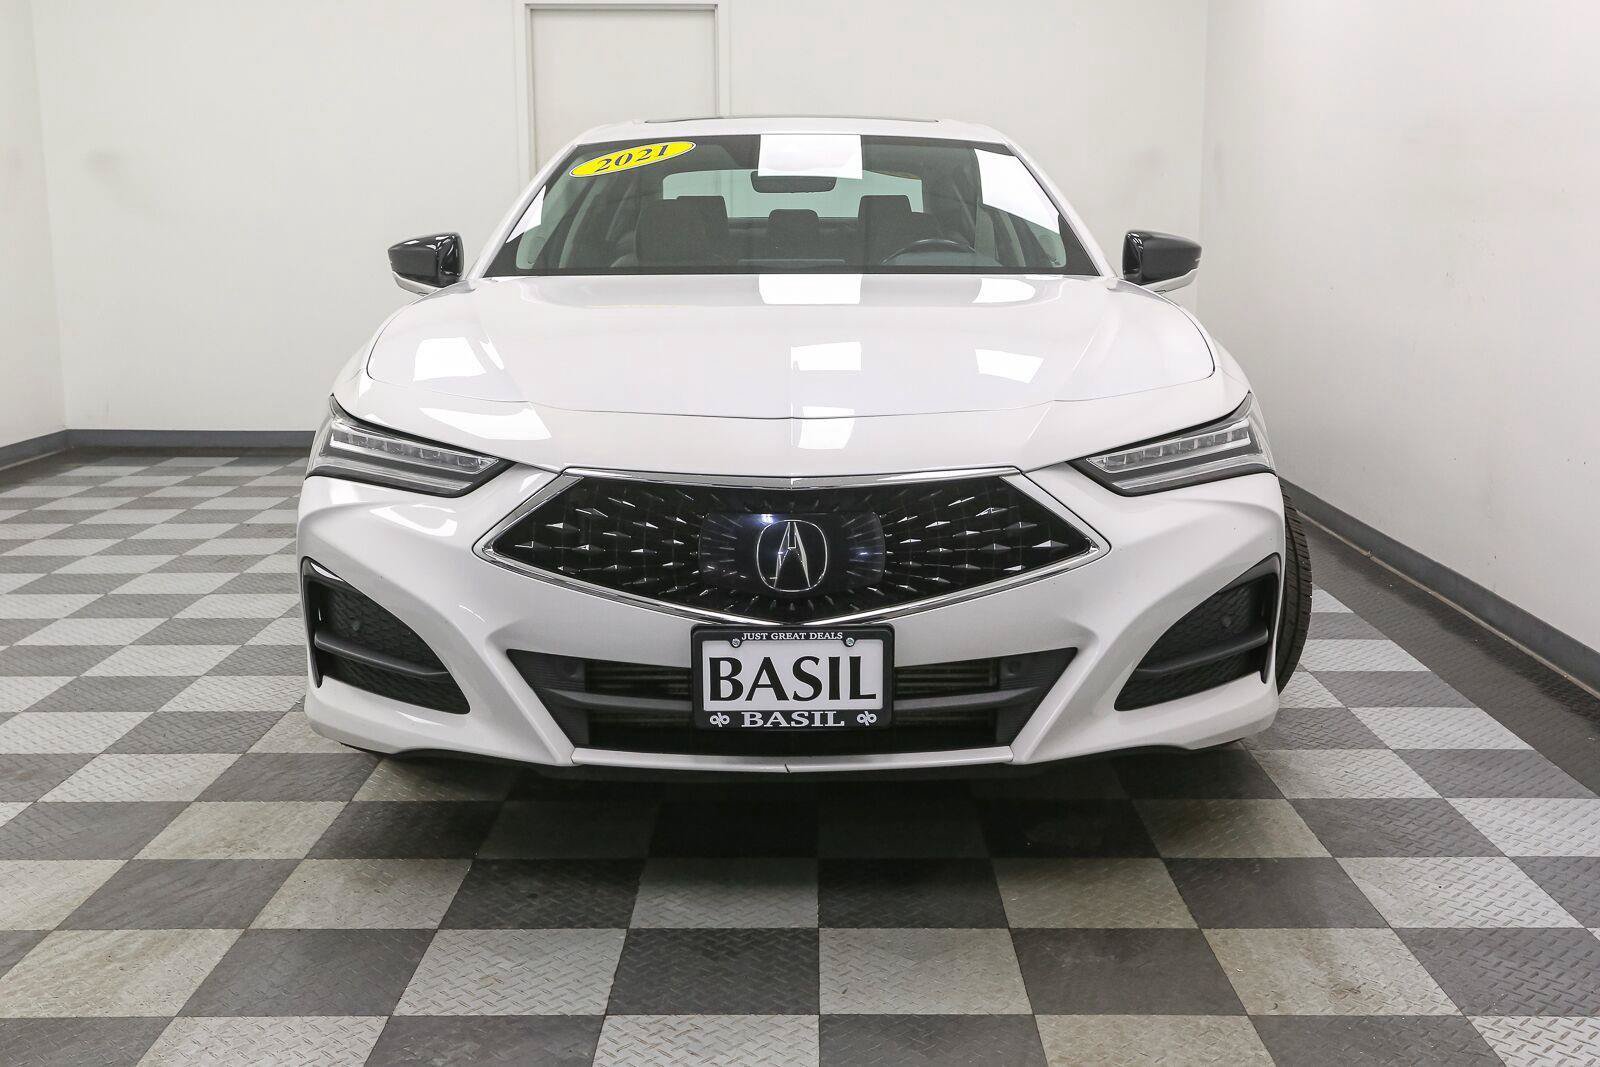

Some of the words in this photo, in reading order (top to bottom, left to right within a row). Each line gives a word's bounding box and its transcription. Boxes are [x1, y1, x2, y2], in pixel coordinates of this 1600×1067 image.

[594, 144, 669, 173] 2021
[741, 632, 768, 640] JUST
[771, 632, 806, 640] GREAT
[809, 632, 843, 640] DEALS
[709, 656, 877, 702] BASIL
[741, 711, 845, 727] BASIL
